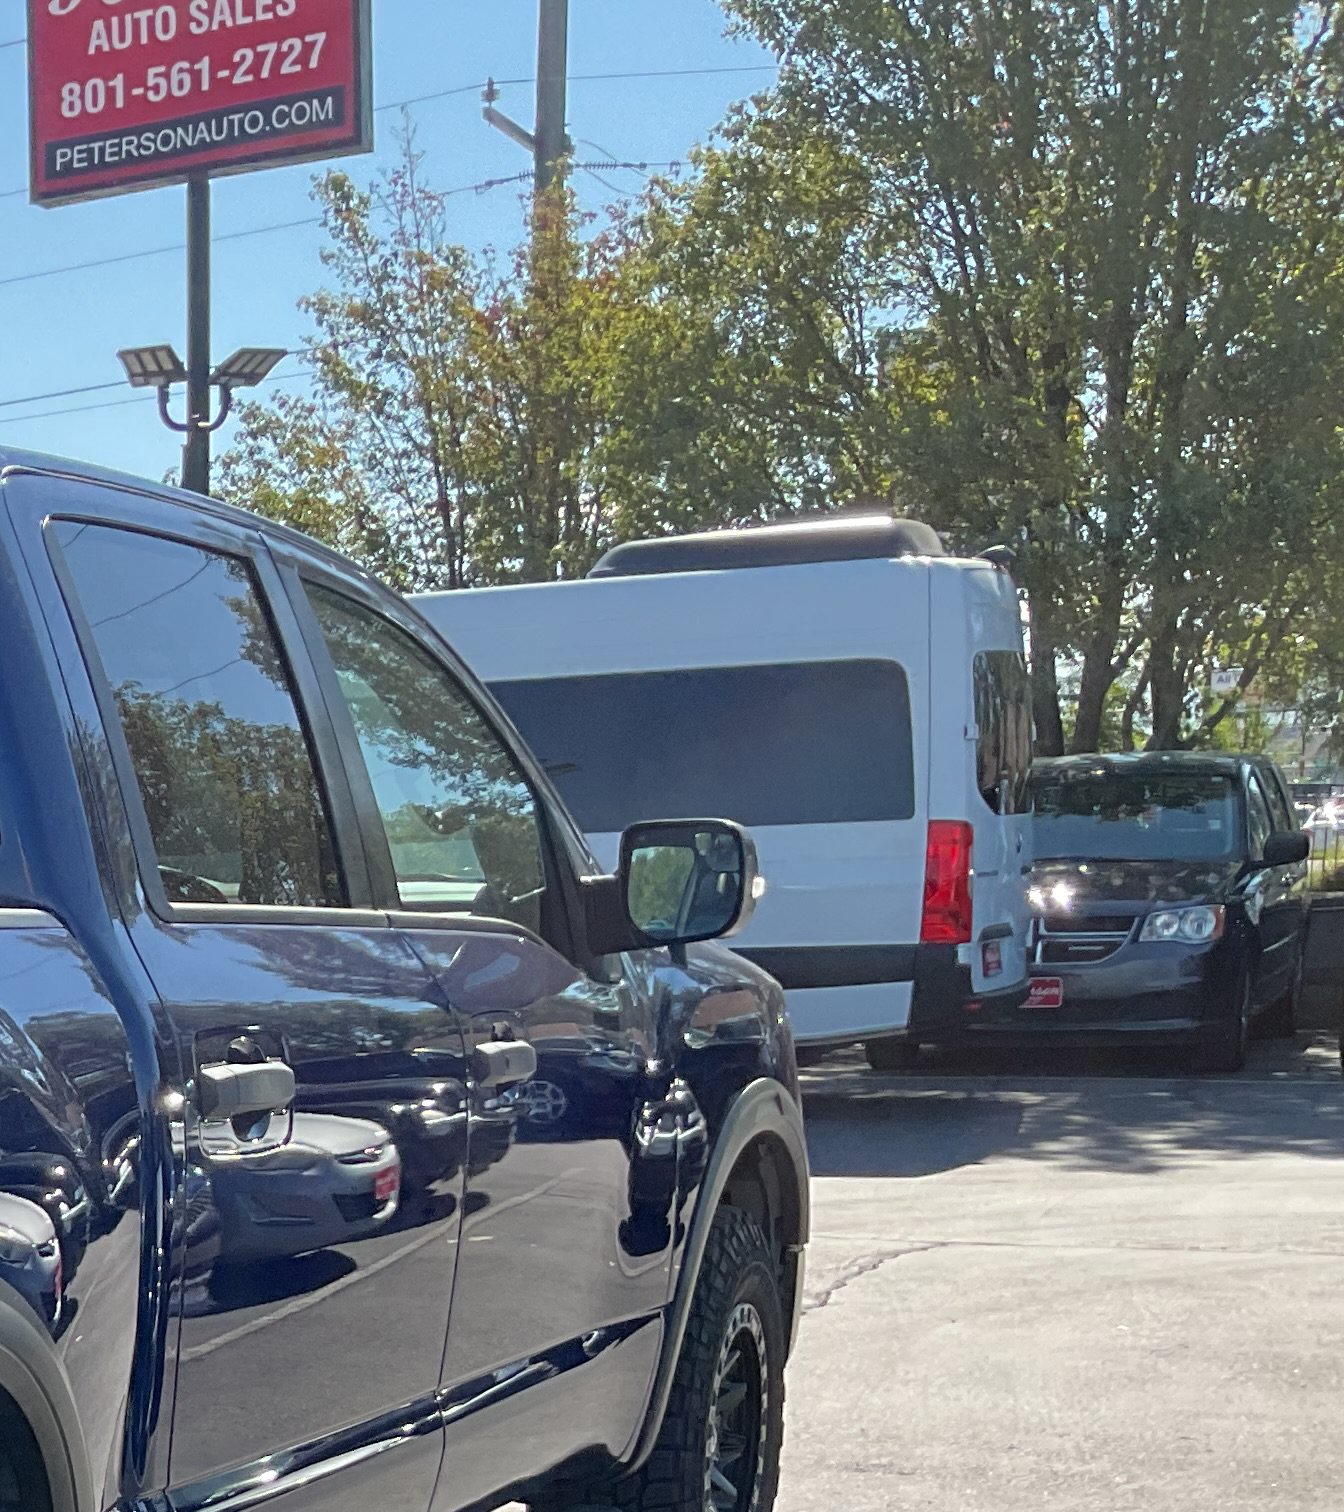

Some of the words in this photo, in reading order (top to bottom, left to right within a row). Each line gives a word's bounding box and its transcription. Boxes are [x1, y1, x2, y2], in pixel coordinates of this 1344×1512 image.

[88, 5, 177, 54] AUTO
[60, 32, 327, 118] 801-561-2727
[55, 96, 334, 171] PETERSONAUTO.COM
